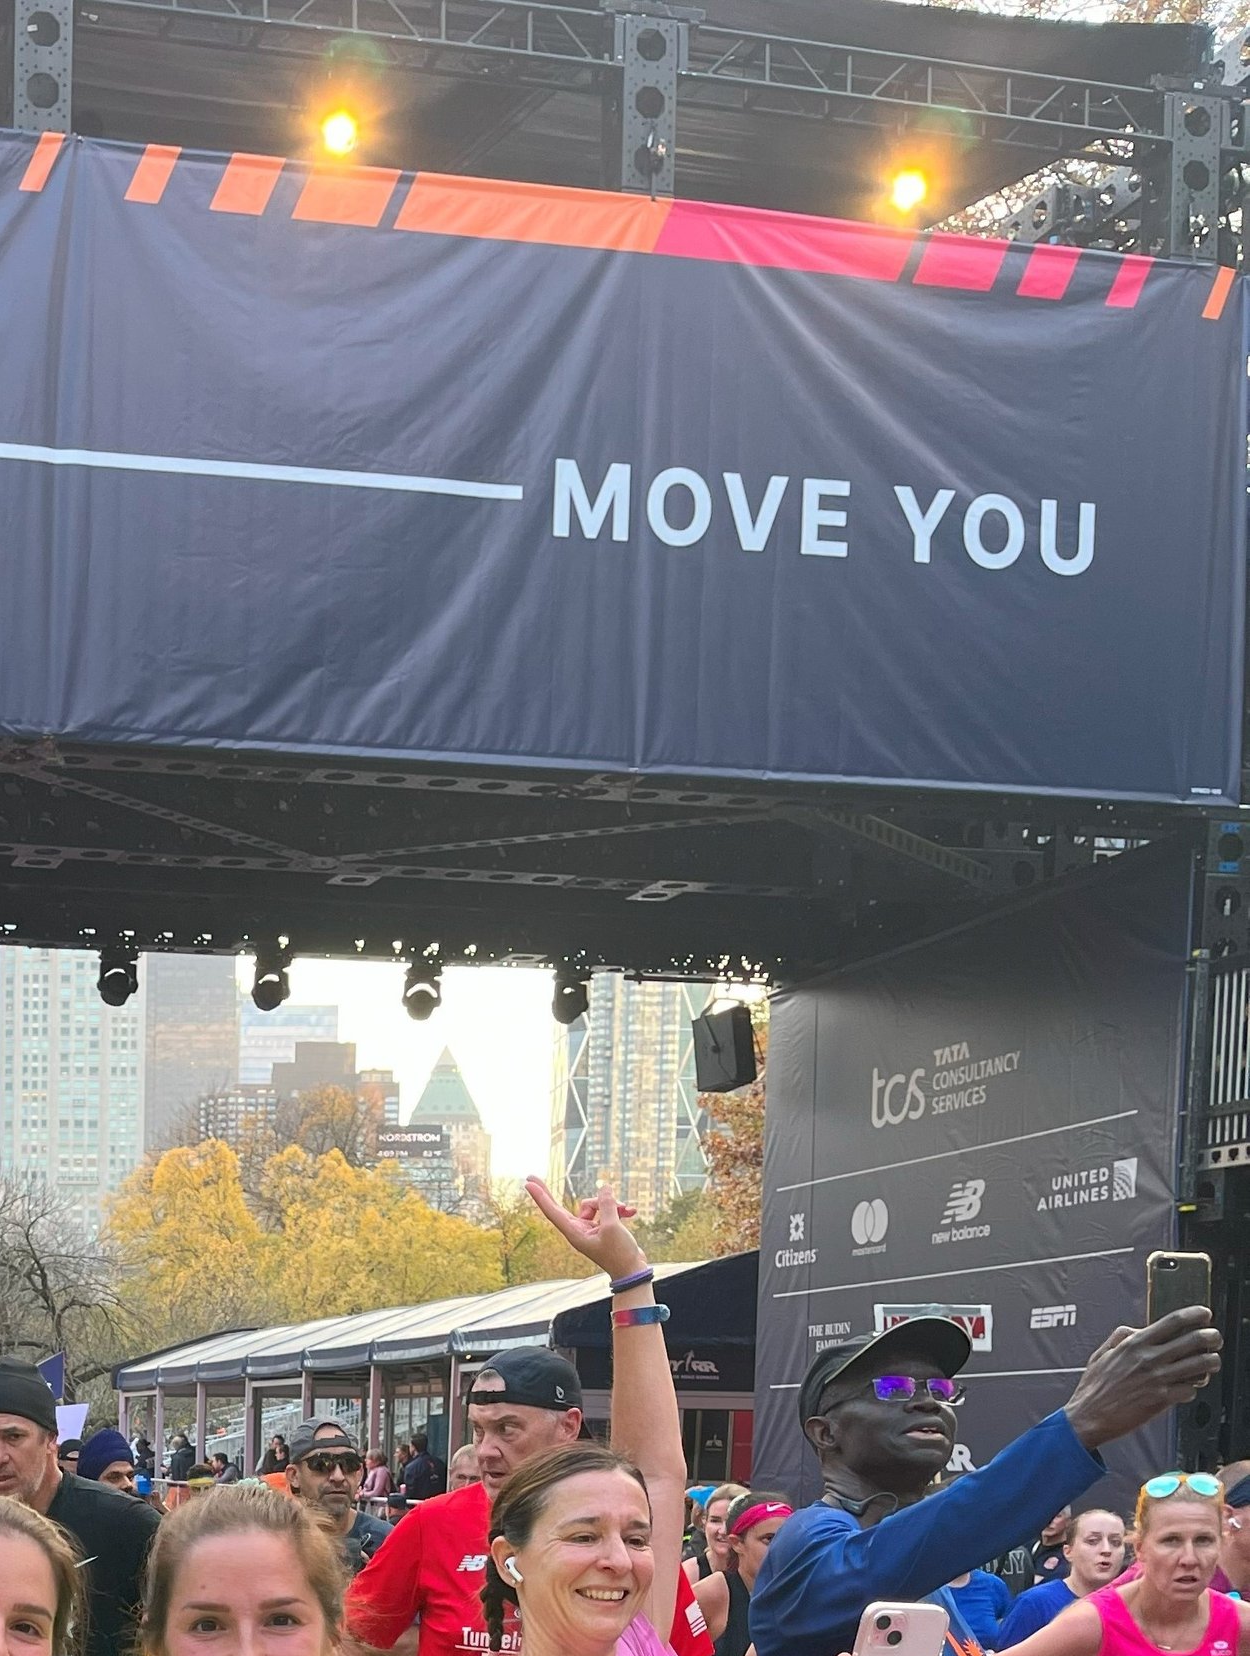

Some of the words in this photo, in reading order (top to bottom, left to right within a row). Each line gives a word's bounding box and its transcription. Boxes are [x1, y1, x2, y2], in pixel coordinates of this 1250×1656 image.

[552, 457, 851, 558] MOVE
[893, 485, 1097, 576] YOU
[933, 1041, 971, 1067] TATA
[932, 1051, 1021, 1091] CONSULTANCY
[871, 1067, 926, 1129] tcs
[931, 1085, 987, 1115] SERVICES
[378, 1133, 441, 1143] NORDSTROM
[1052, 1167, 1109, 1190] UNITED
[1037, 1185, 1109, 1212] AIRLINES
[932, 1229, 951, 1245] new
[951, 1224, 991, 1242] balance
[775, 1248, 817, 1269] Citizens
[808, 1324, 823, 1338] THE
[824, 1321, 851, 1336] RUDIN
[1030, 1304, 1077, 1330] ESPN
[461, 1626, 517, 1650] Tunel
